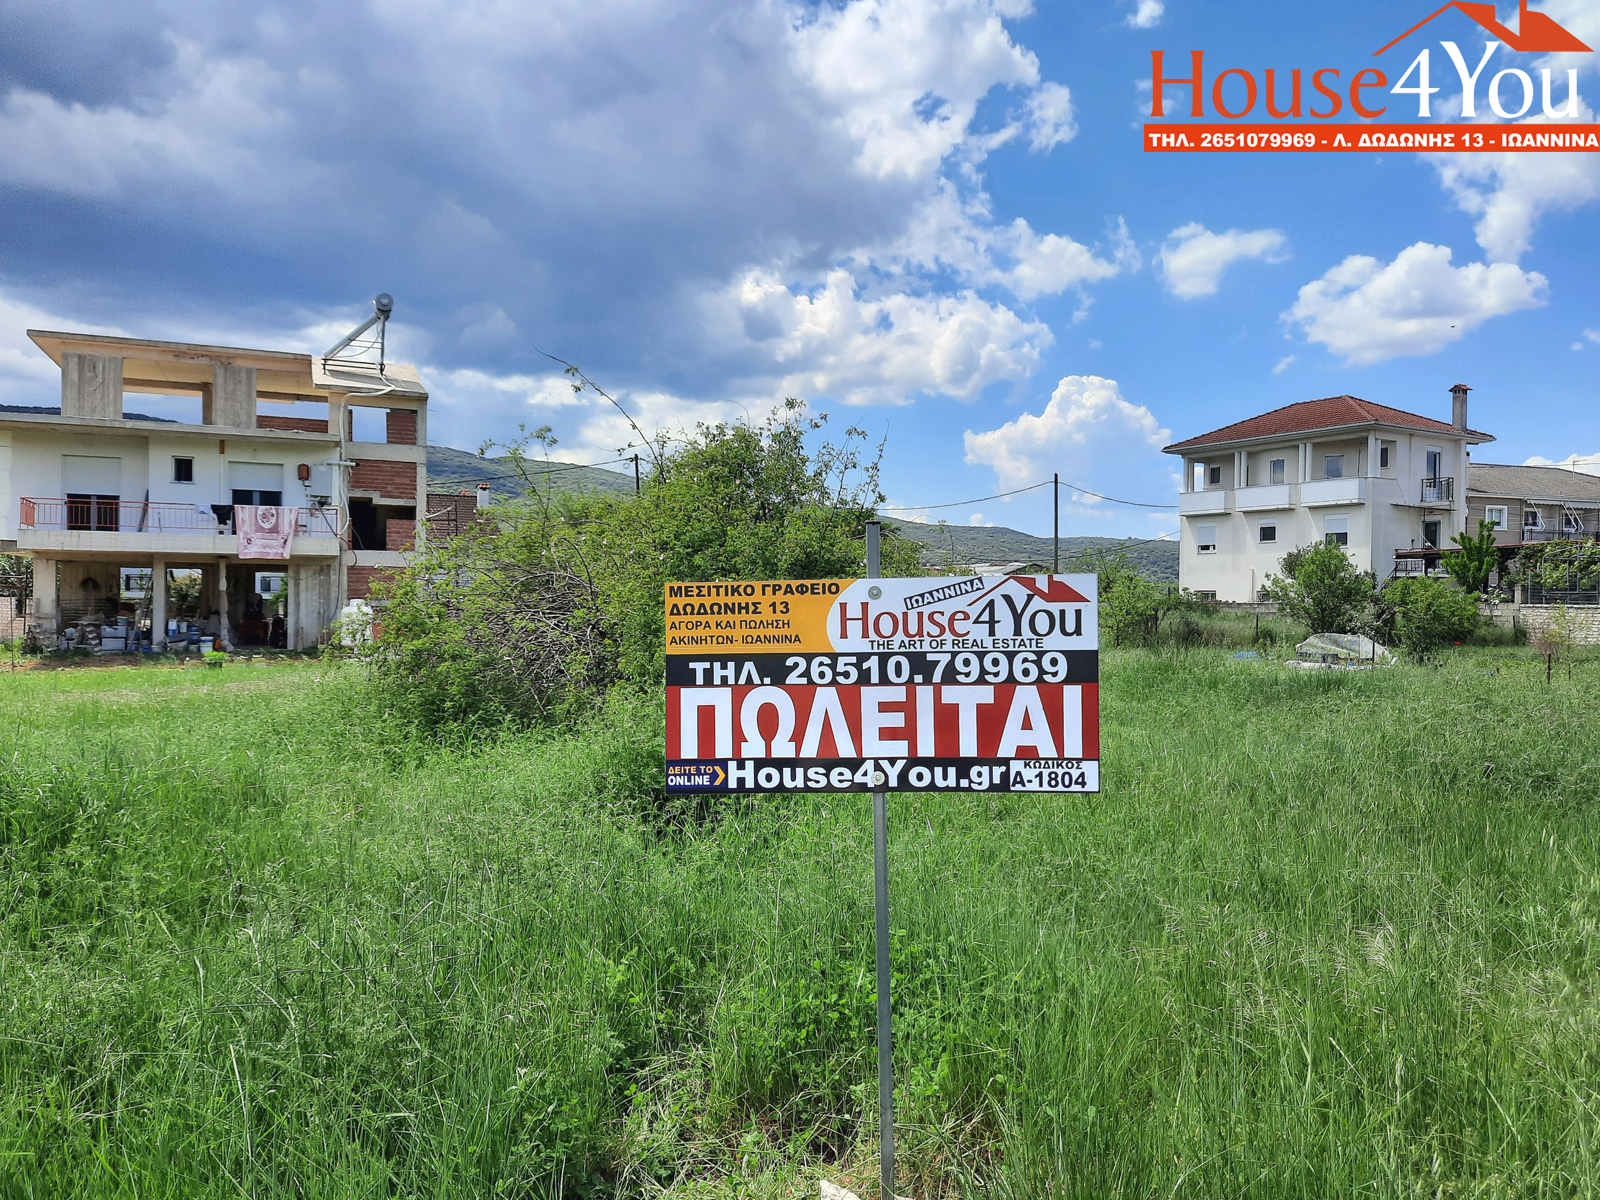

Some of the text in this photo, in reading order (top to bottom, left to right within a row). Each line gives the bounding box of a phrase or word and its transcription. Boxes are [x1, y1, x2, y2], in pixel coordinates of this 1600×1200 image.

[668, 582, 841, 598] ΜΕΣΙΤΙΚΟ ΓΡΑΦΕΙΟ
[906, 580, 984, 610] ΙΩΑΝΝΙΝΑ
[668, 601, 790, 616] ΔΩΔΩΝΗΣ 13
[838, 593, 1083, 640] House4You
[669, 619, 790, 631] ΑΓΟΡΑ ΚΑΙ ΠΩΛΗΣΗ
[741, 634, 802, 645] ΙΩΑΝΝΙΝΑ
[868, 638, 1045, 651] THE ART OF REAL ESTATE
[688, 651, 1069, 685] ΤΗΛ. 26510.79969
[680, 685, 1083, 759] ΠΩΛΕΙΤΑΙ
[668, 765, 713, 774] ΔΕΙΤΕ ΤΟ
[1023, 760, 1083, 770] ΚΩΔΙΚΟΣ
[667, 775, 711, 786] ONLINE
[727, 759, 1007, 790] House4You.gr
[1010, 770, 1088, 789] A-1804
